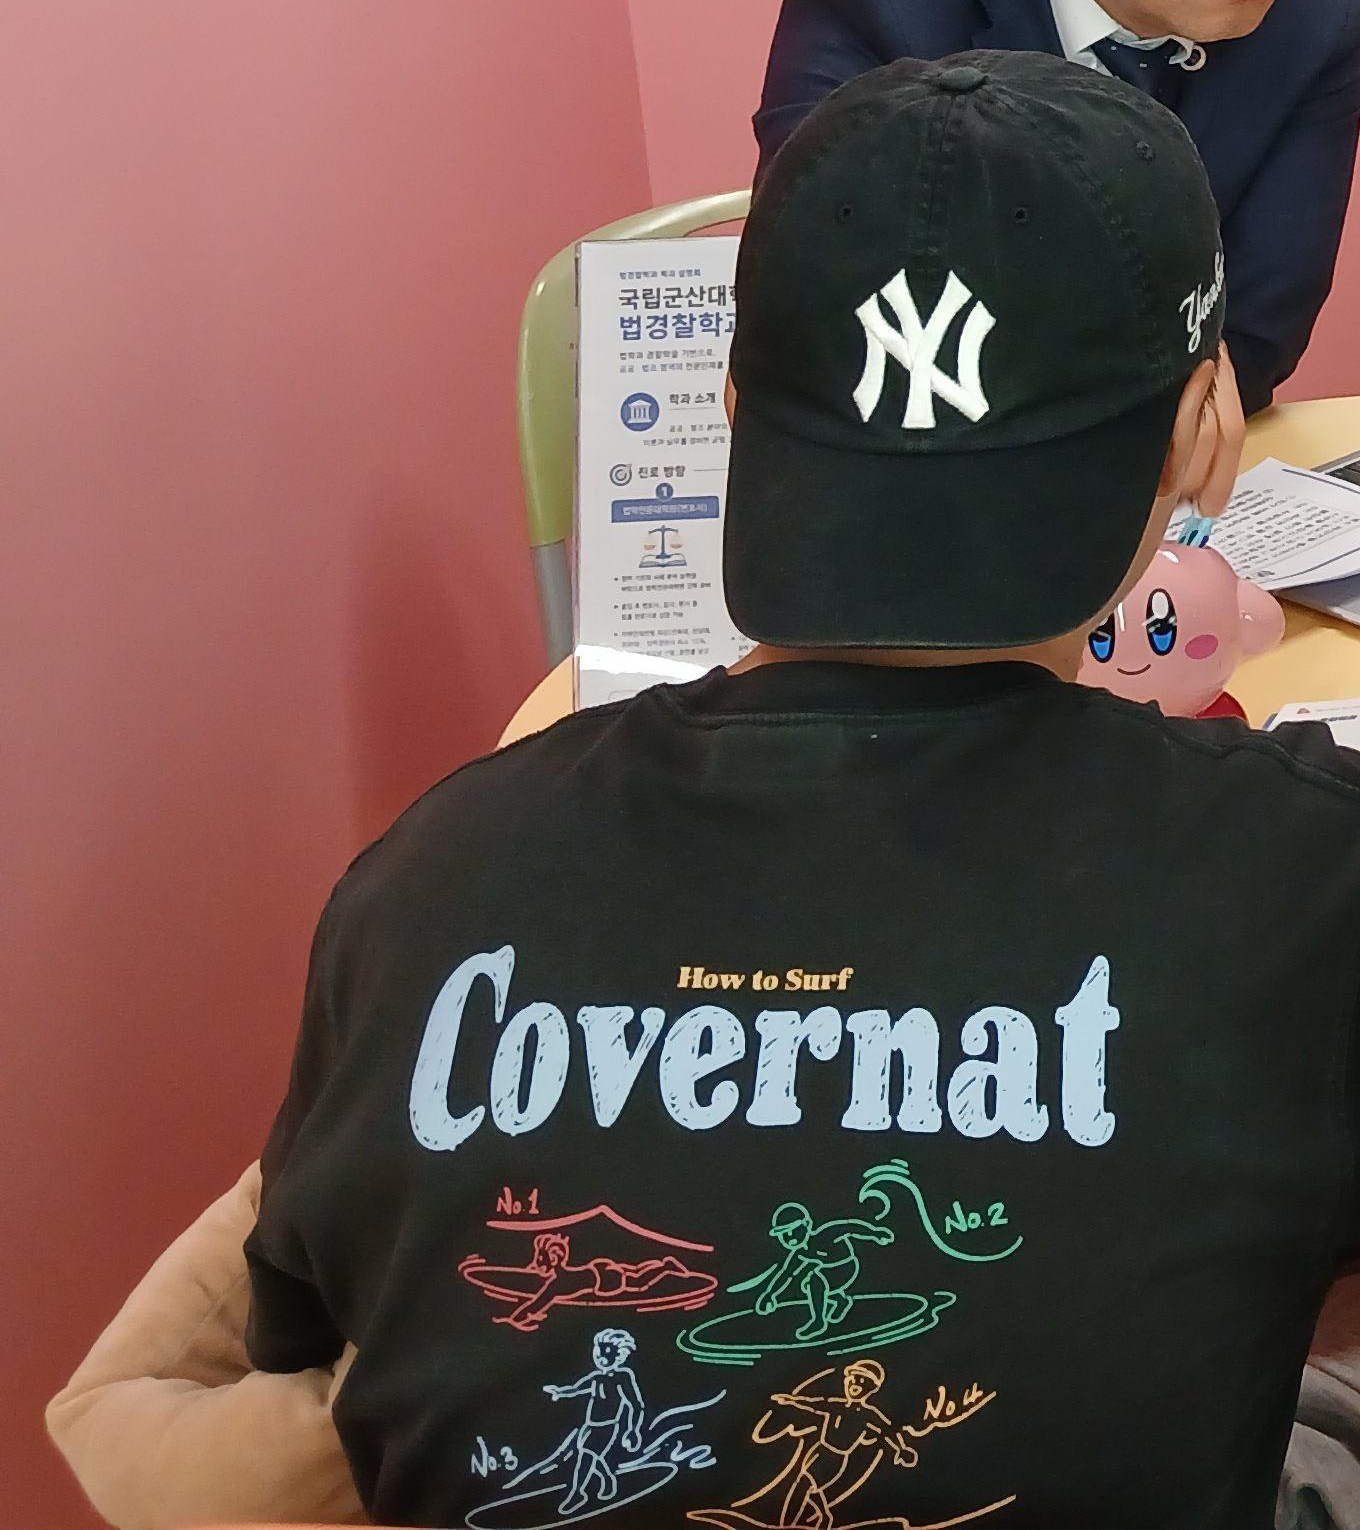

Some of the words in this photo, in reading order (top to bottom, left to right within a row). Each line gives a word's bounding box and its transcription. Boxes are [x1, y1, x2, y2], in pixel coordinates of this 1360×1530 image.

[853, 268, 997, 429] NY
[669, 393, 691, 405] 학과
[694, 392, 716, 404] 소개
[638, 466, 659, 479] 진로
[660, 486, 669, 497] 1
[677, 965, 746, 990] How
[751, 969, 779, 992] to
[784, 966, 855, 992] Surf
[408, 943, 1122, 1151] Covernat
